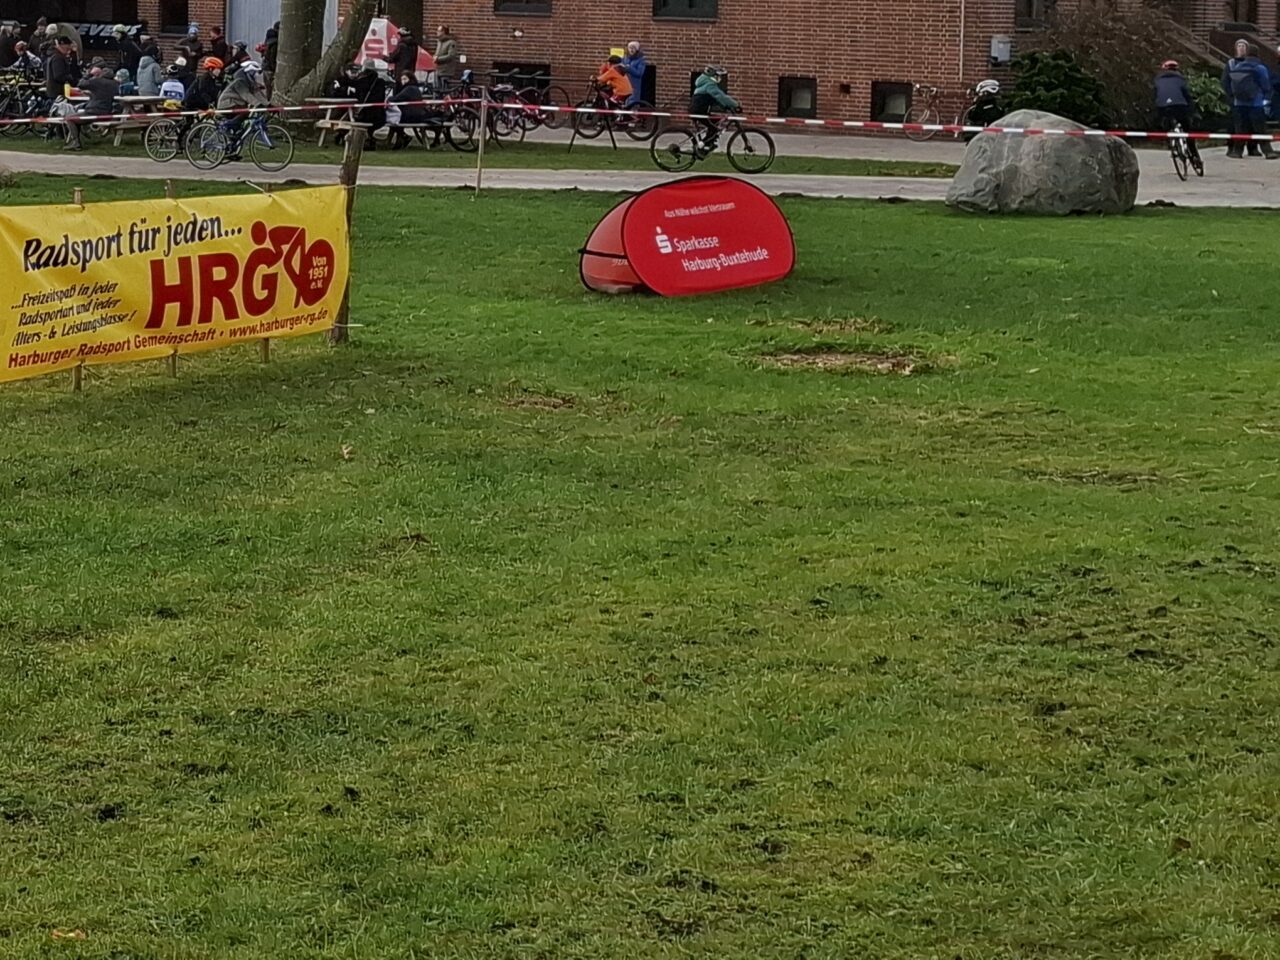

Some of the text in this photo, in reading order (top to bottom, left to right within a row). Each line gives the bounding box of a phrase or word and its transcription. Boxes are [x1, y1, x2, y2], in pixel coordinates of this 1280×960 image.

[23, 212, 242, 273] Radsport für jeden...
[673, 236, 720, 254] Sparkasse
[308, 265, 329, 280] 1951
[681, 245, 770, 272] Harburg-Buxtehude
[77, 283, 88, 297] in
[88, 280, 119, 298] jeder
[144, 248, 282, 329] HRG
[18, 297, 121, 327] Radsportart und jeder
[8, 307, 329, 369] Harburger Radsport Gemeinschaft www.harburger-rg.de
